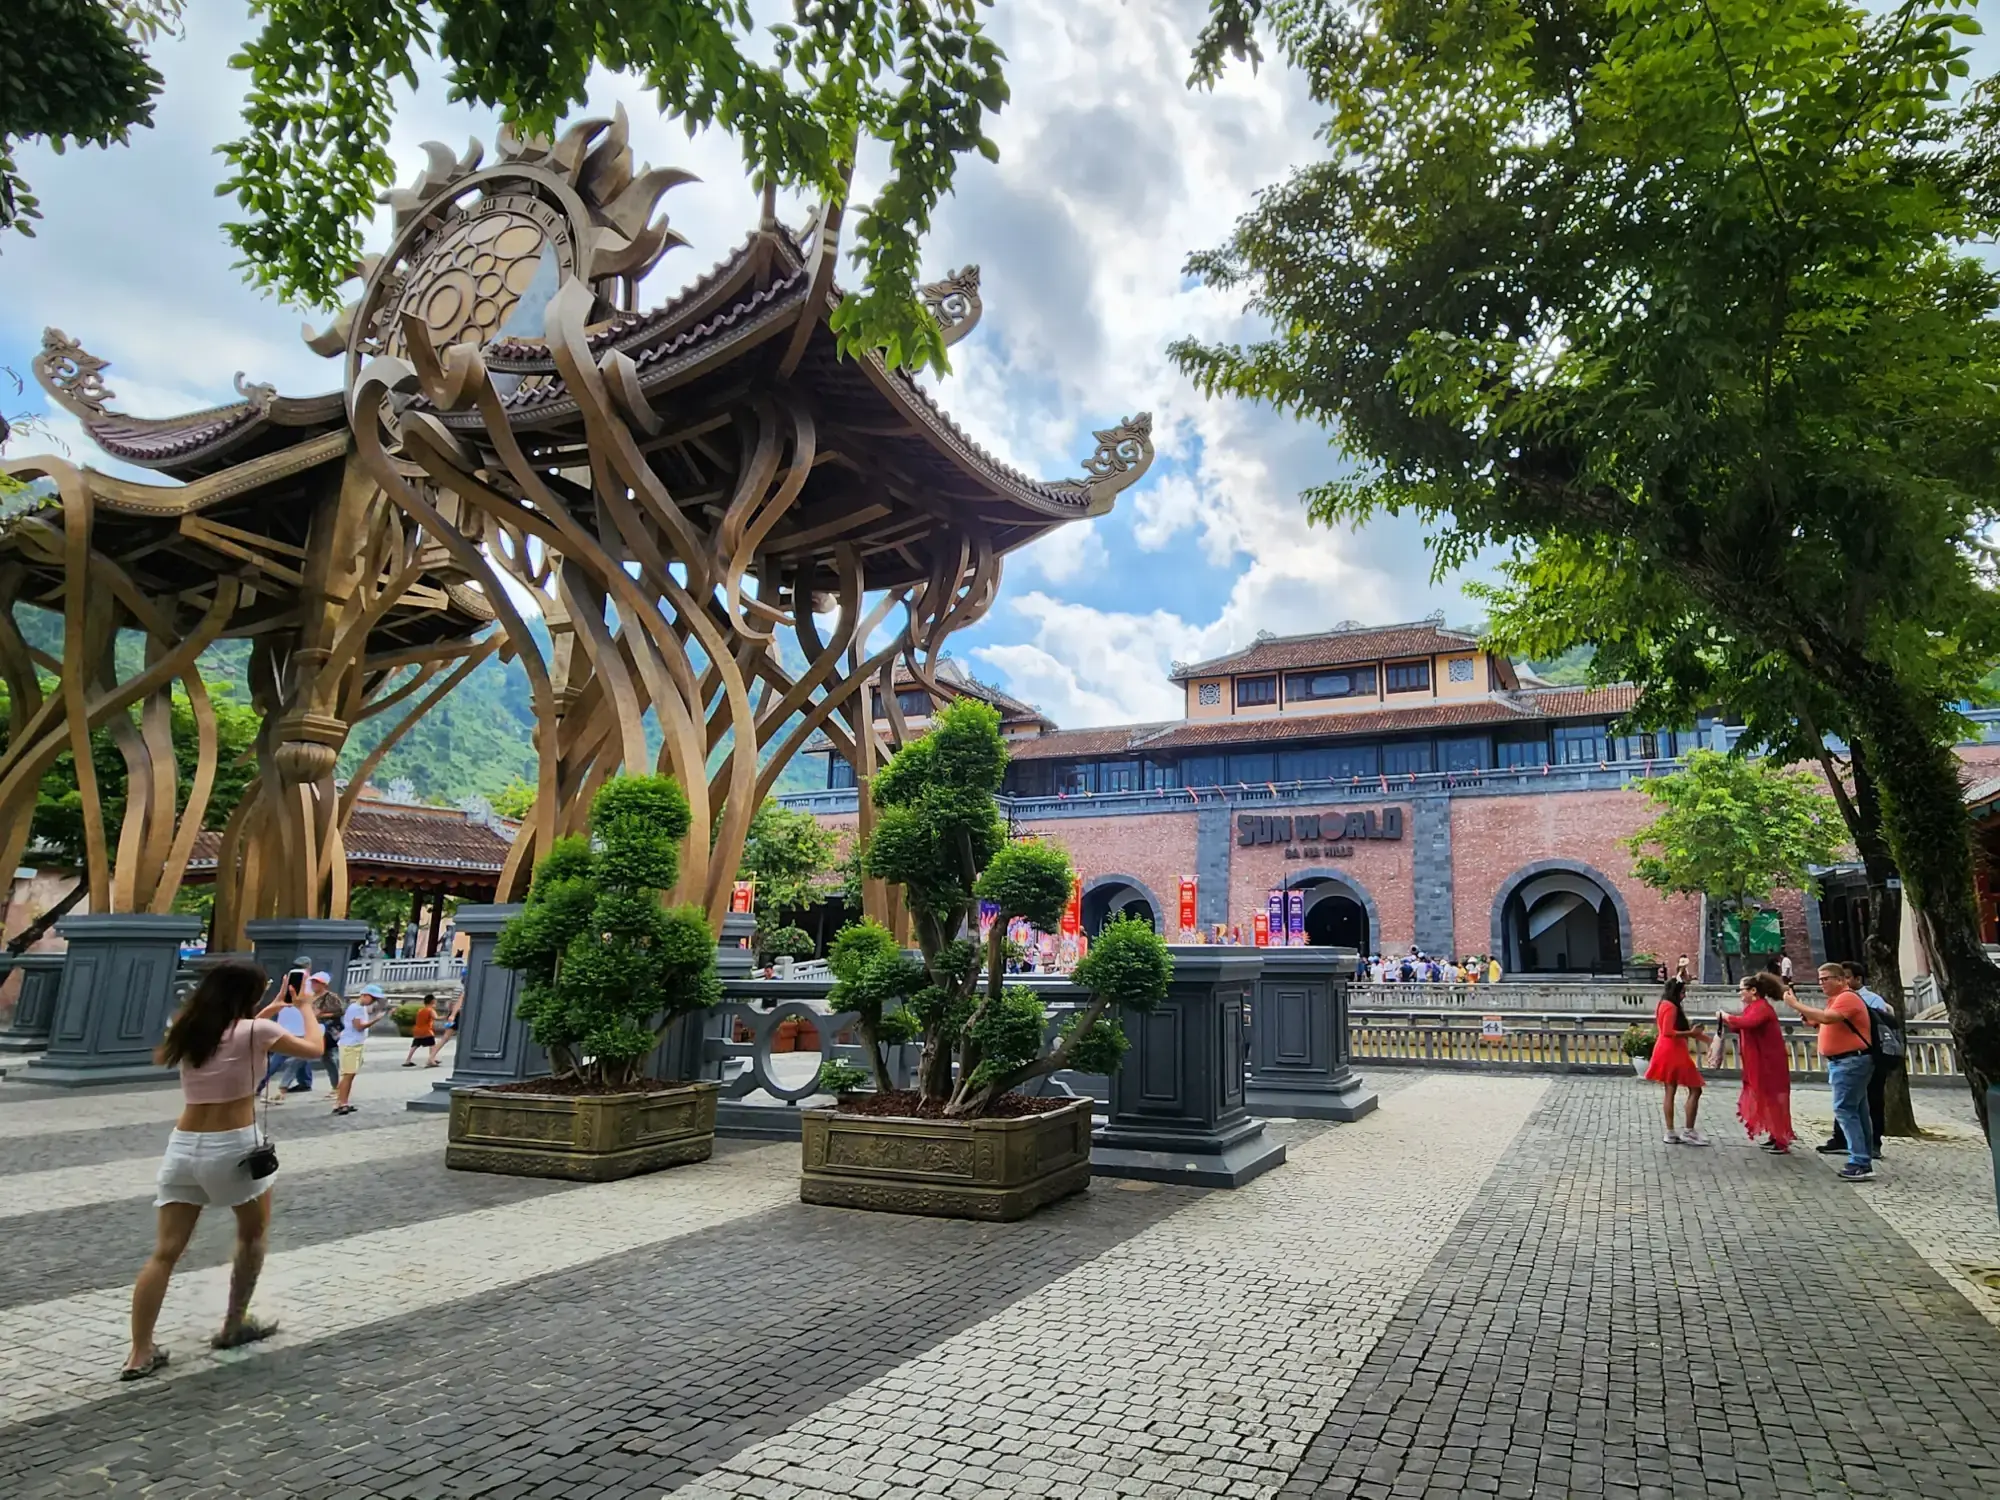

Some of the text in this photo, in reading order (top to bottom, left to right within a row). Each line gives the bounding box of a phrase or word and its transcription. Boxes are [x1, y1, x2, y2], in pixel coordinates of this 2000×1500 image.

[526, 201, 537, 214] II
[543, 212, 555, 227] III
[1237, 807, 1403, 846] SUN WORLD
[1324, 846, 1354, 858] HILLS
